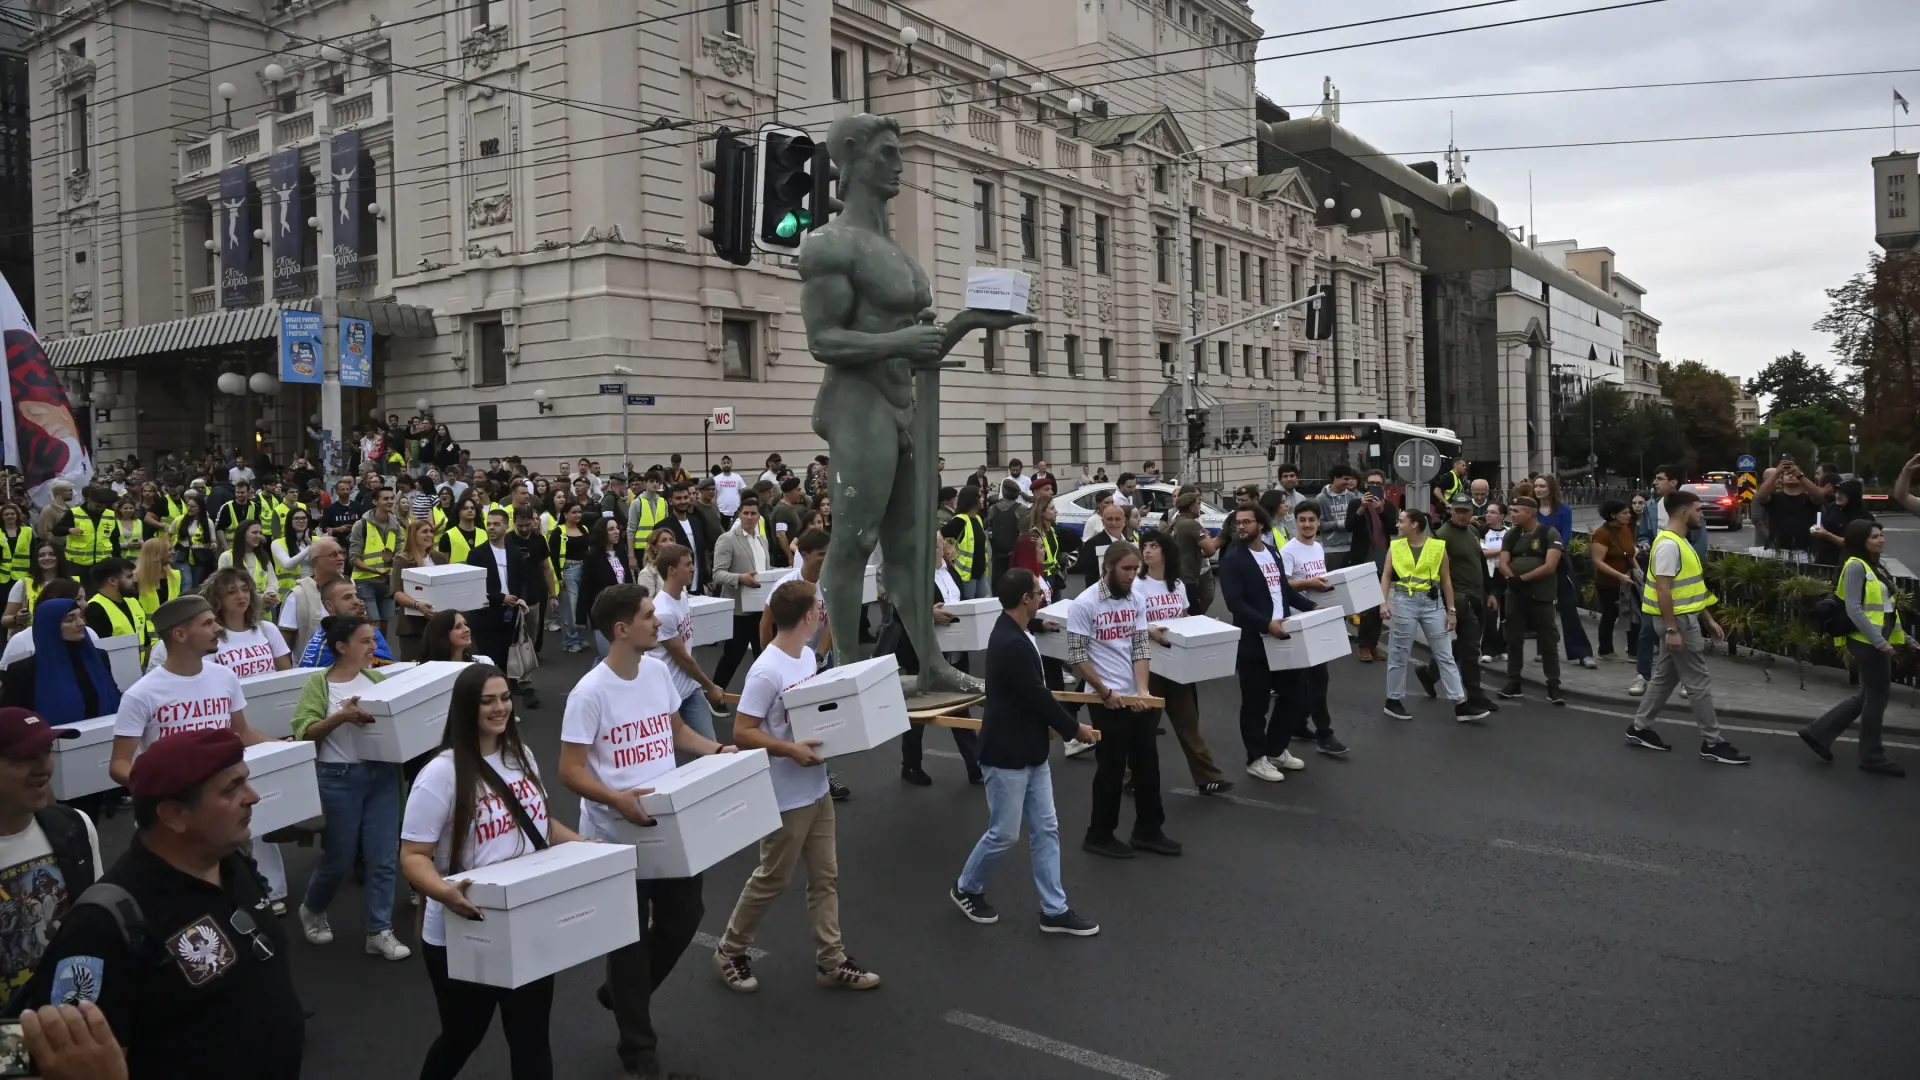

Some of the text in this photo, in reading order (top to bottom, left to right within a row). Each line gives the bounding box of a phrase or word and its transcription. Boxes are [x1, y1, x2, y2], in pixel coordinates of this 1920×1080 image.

[479, 137, 499, 156] 1922
[715, 412, 730, 425] WC
[610, 712, 671, 745] СТУДЕНТ
